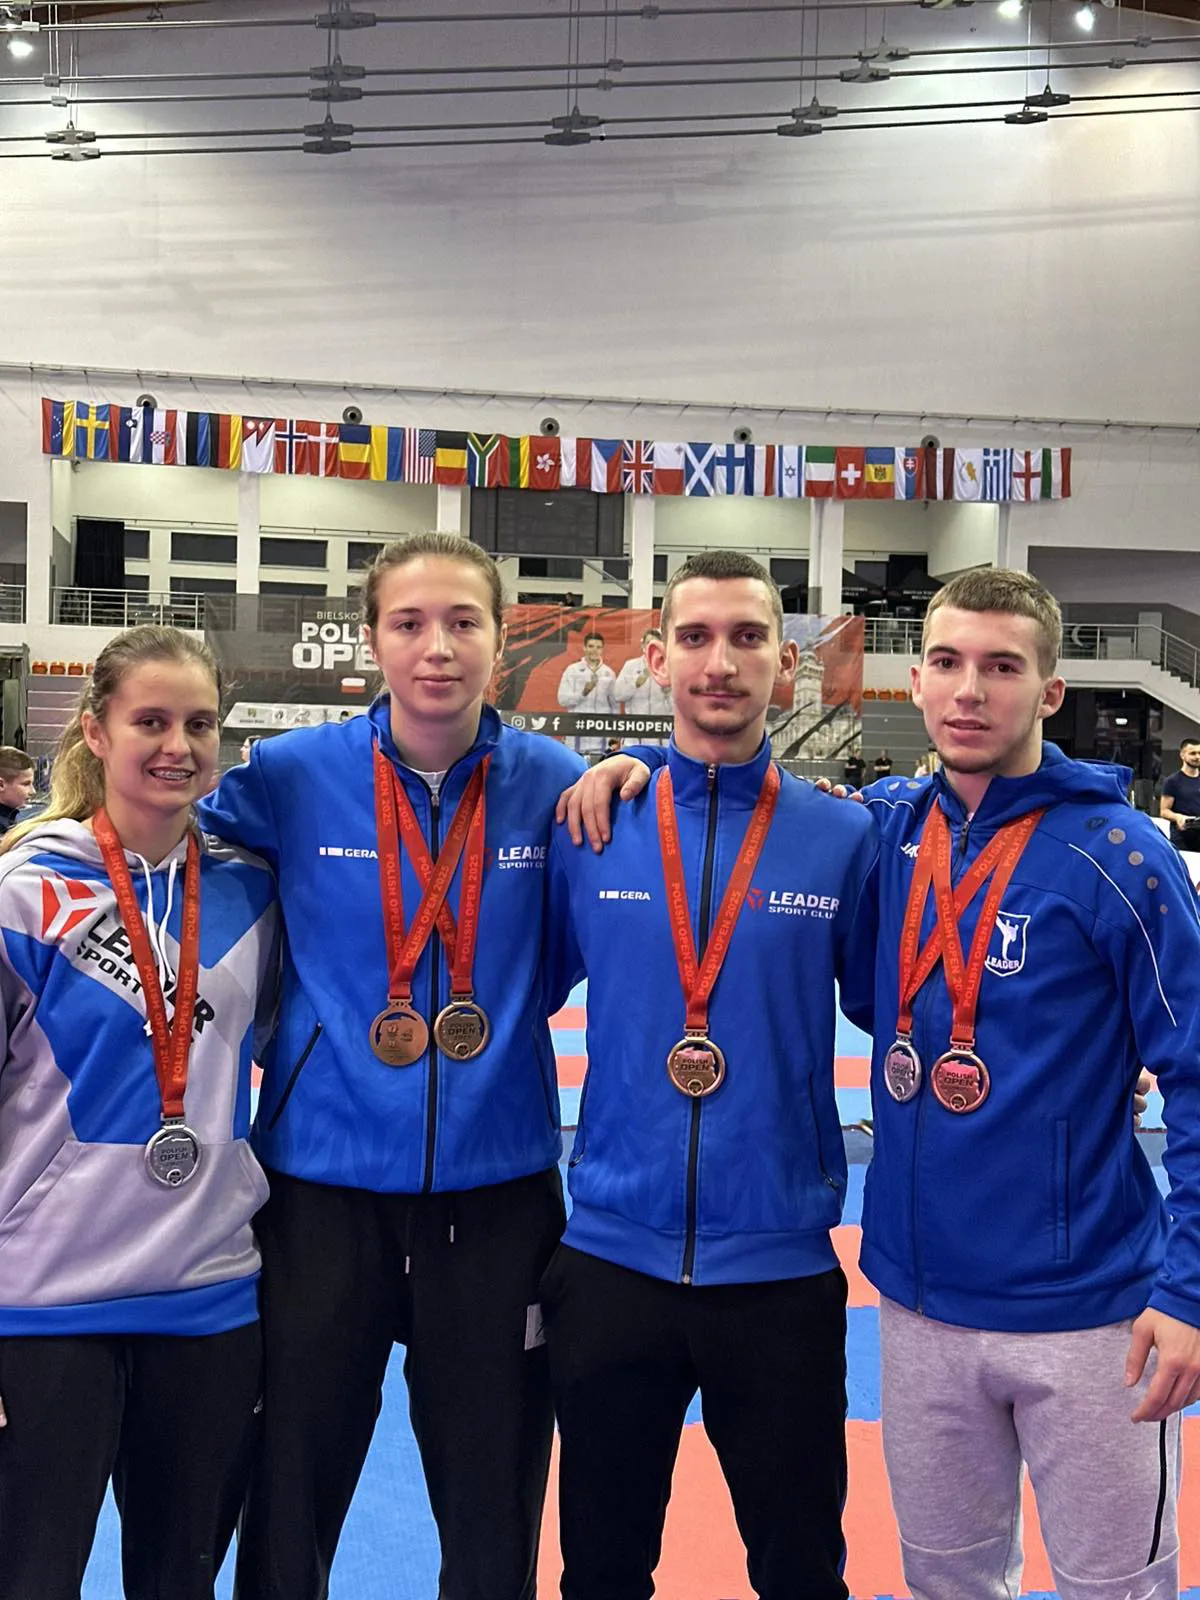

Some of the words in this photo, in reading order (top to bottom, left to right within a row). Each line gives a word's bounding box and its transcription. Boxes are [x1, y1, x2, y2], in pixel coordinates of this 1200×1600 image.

[316, 611, 360, 621] BIELSKO
[302, 622, 365, 643] POLI
[293, 643, 379, 670] OPE
[575, 719, 673, 733] #POLISHOPEN
[344, 848, 379, 860] GERA
[468, 853, 479, 881] 2025
[498, 845, 547, 861] LEADE
[385, 853, 397, 896] POLISH
[464, 884, 477, 917] OPEN
[620, 890, 651, 901] GERA
[672, 882, 687, 926] POLISH
[768, 890, 840, 912] LEADER
[908, 883, 924, 928] POLISH
[388, 899, 401, 932] OPEN
[401, 926, 426, 967] POLISH
[420, 891, 438, 924] OPEN
[433, 864, 450, 892] 2025
[768, 906, 809, 917] SPORT
[810, 909, 835, 921] CLU
[941, 894, 955, 938] POLISH
[460, 919, 473, 963] POLISH
[678, 928, 692, 960] OPEN
[698, 953, 720, 997] POLISH
[713, 919, 732, 952] OPEN
[725, 890, 742, 919] 2025
[963, 962, 979, 1008] POLISH
[975, 926, 989, 959] OPEN
[984, 895, 999, 923] 2025
[947, 941, 961, 976] OPEN
[986, 954, 1020, 970] LEADER
[143, 964, 160, 1009] POLISH
[183, 968, 194, 997] 2025
[178, 1001, 191, 1034] OPEN
[172, 1036, 188, 1083] POLISH
[160, 1152, 189, 1161] OPEN
